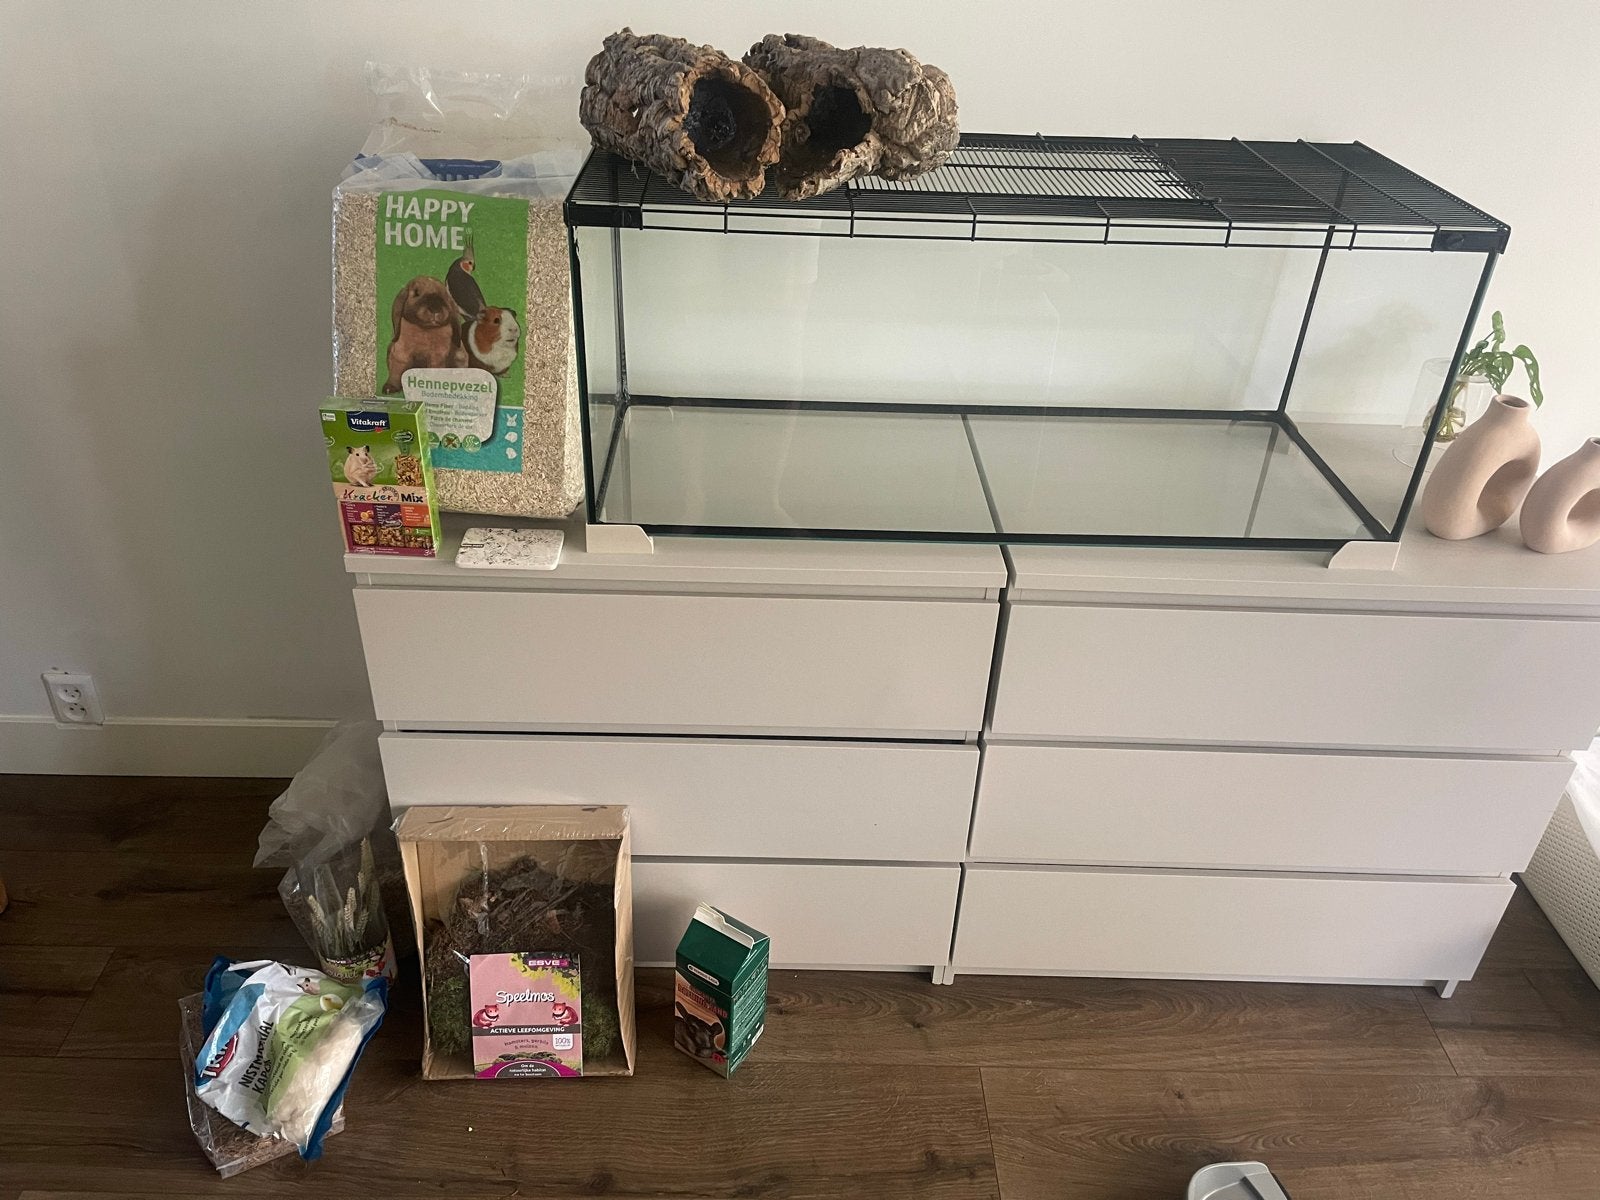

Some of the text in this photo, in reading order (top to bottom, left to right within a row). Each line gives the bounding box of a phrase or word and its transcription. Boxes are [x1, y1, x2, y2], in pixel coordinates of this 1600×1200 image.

[385, 195, 475, 224] HAPPY
[384, 222, 465, 251] HOME
[408, 376, 493, 393] Hennepvezel
[351, 418, 386, 427] Vitakraft
[401, 493, 424, 503] Mix
[496, 988, 556, 1006] Speelmos
